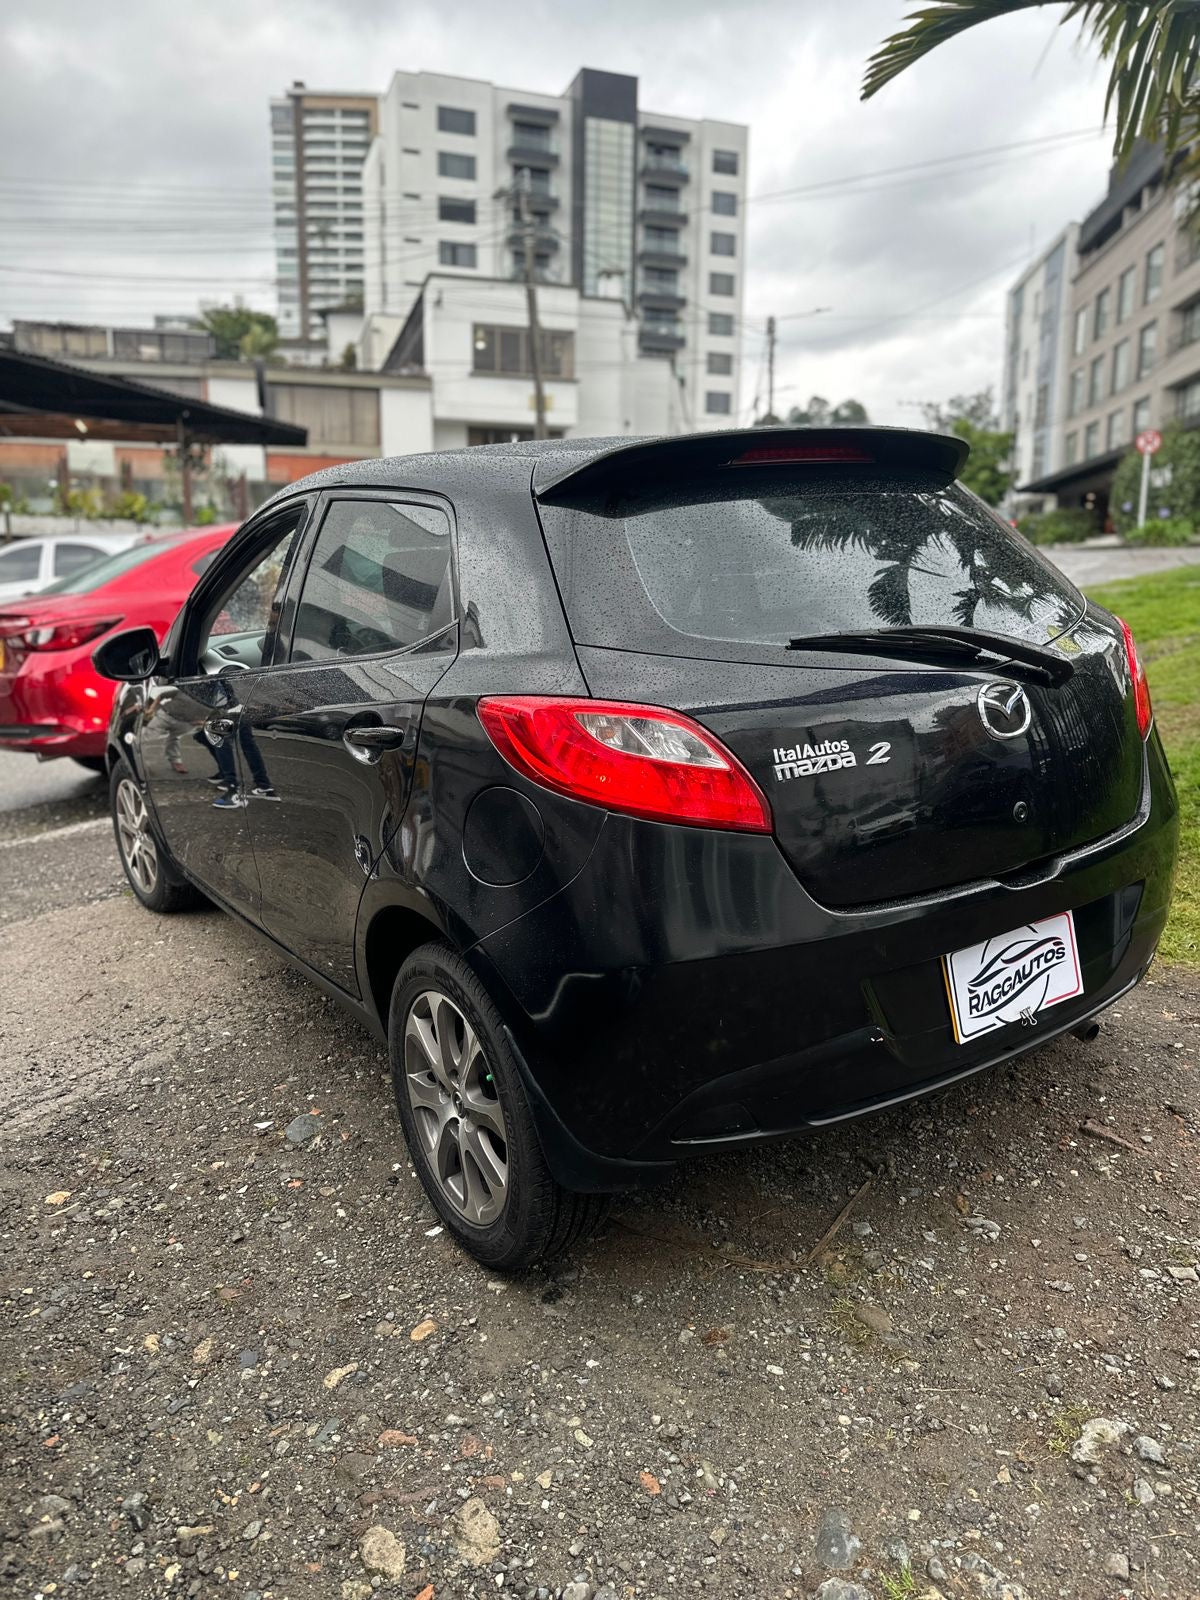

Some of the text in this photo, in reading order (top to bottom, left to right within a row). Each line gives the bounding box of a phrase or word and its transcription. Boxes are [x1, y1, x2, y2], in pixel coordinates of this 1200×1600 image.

[773, 739, 849, 763] ItalAutos
[866, 741, 892, 765] 2
[968, 947, 1066, 1015] RAGGAUTOS
